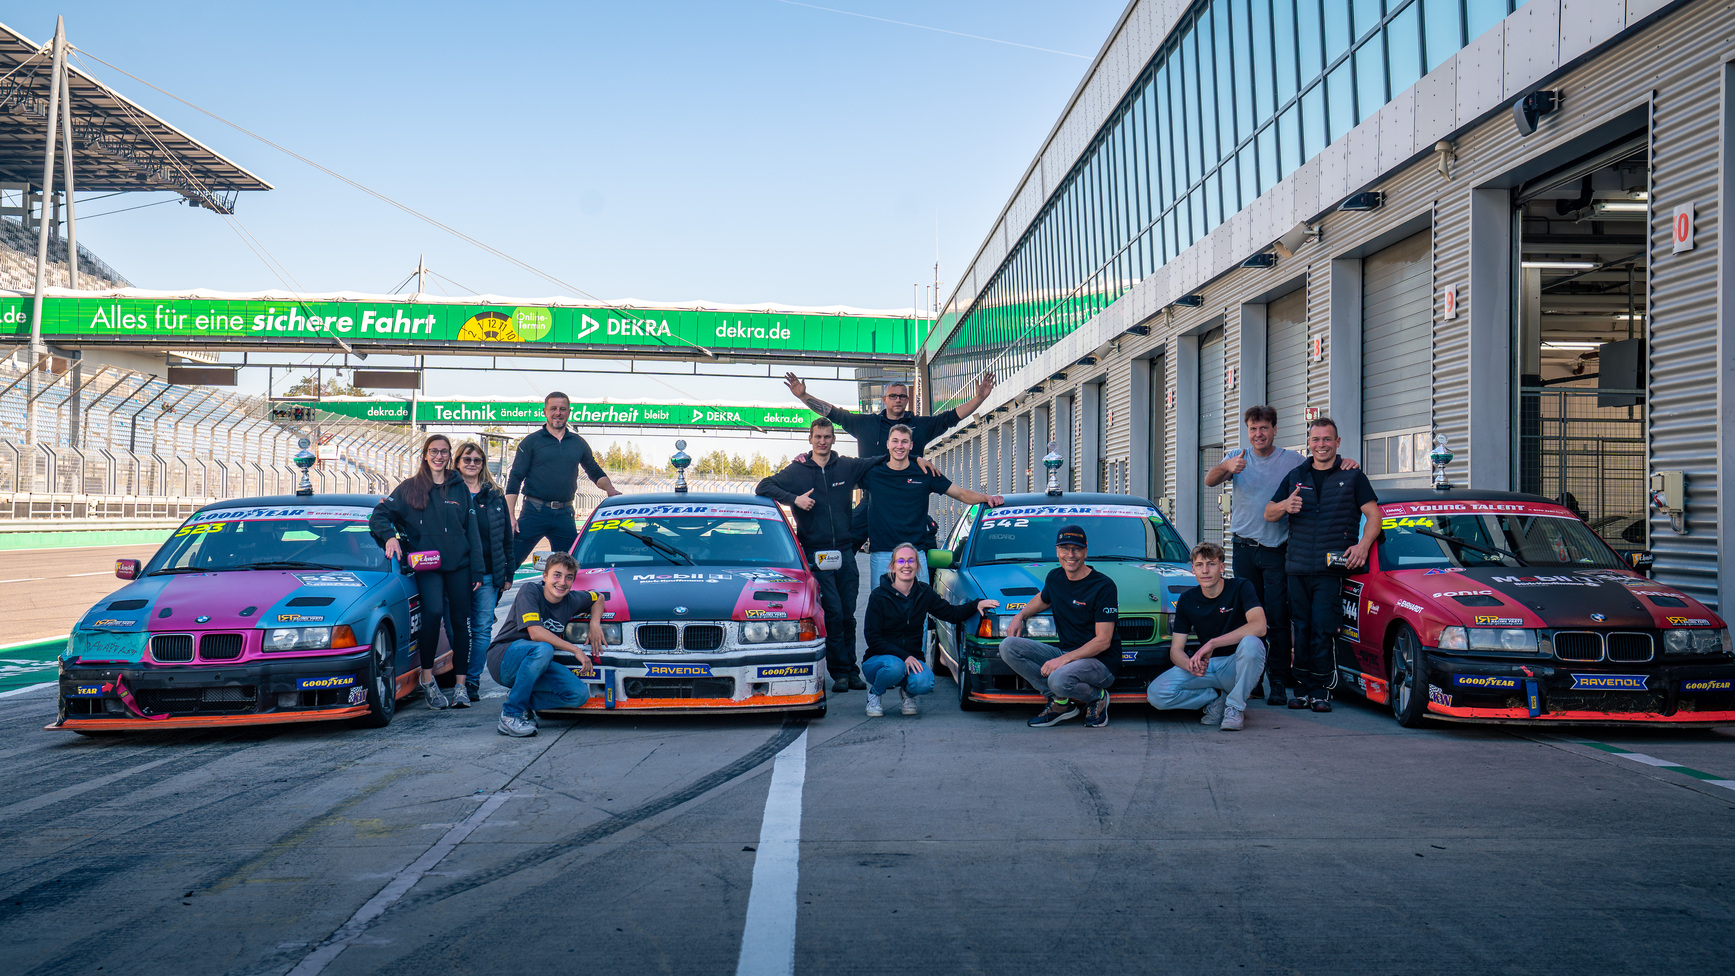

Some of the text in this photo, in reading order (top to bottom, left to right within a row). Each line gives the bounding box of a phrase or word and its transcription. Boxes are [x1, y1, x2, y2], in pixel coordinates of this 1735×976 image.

[1447, 291, 1454, 313] 9
[90, 304, 436, 334] Alles für eine sichere Fahrt
[516, 312, 548, 322] Online-
[487, 319, 497, 329] 12
[506, 329, 517, 341] 10
[518, 321, 546, 330] Termin
[607, 318, 672, 337] DEKRA
[715, 320, 791, 340] dekra.de
[367, 406, 409, 417] dekra.de
[434, 405, 496, 420] Technik
[500, 406, 532, 418] ändert
[568, 405, 639, 422] icherheit
[643, 408, 670, 421] bleibt
[706, 411, 741, 422] DEKRA
[763, 412, 804, 424] dekra.de
[1409, 504, 1466, 512] YOUNG
[1472, 503, 1525, 512] TALENT
[588, 519, 635, 532] 524
[981, 518, 1030, 530] 542
[1382, 516, 1434, 530] 544
[174, 522, 227, 538] 523
[988, 533, 1016, 541] RECARO
[633, 573, 703, 581] Mobil
[1491, 575, 1573, 583] Mobil
[651, 665, 708, 675] RAVENOL
[761, 667, 809, 677] GOODYEAR
[302, 677, 354, 687] GOODYEAR
[1458, 677, 1515, 687] GOODYEAR
[1579, 678, 1640, 687] RAVENOL
[1685, 680, 1731, 691] GOODYEAR
